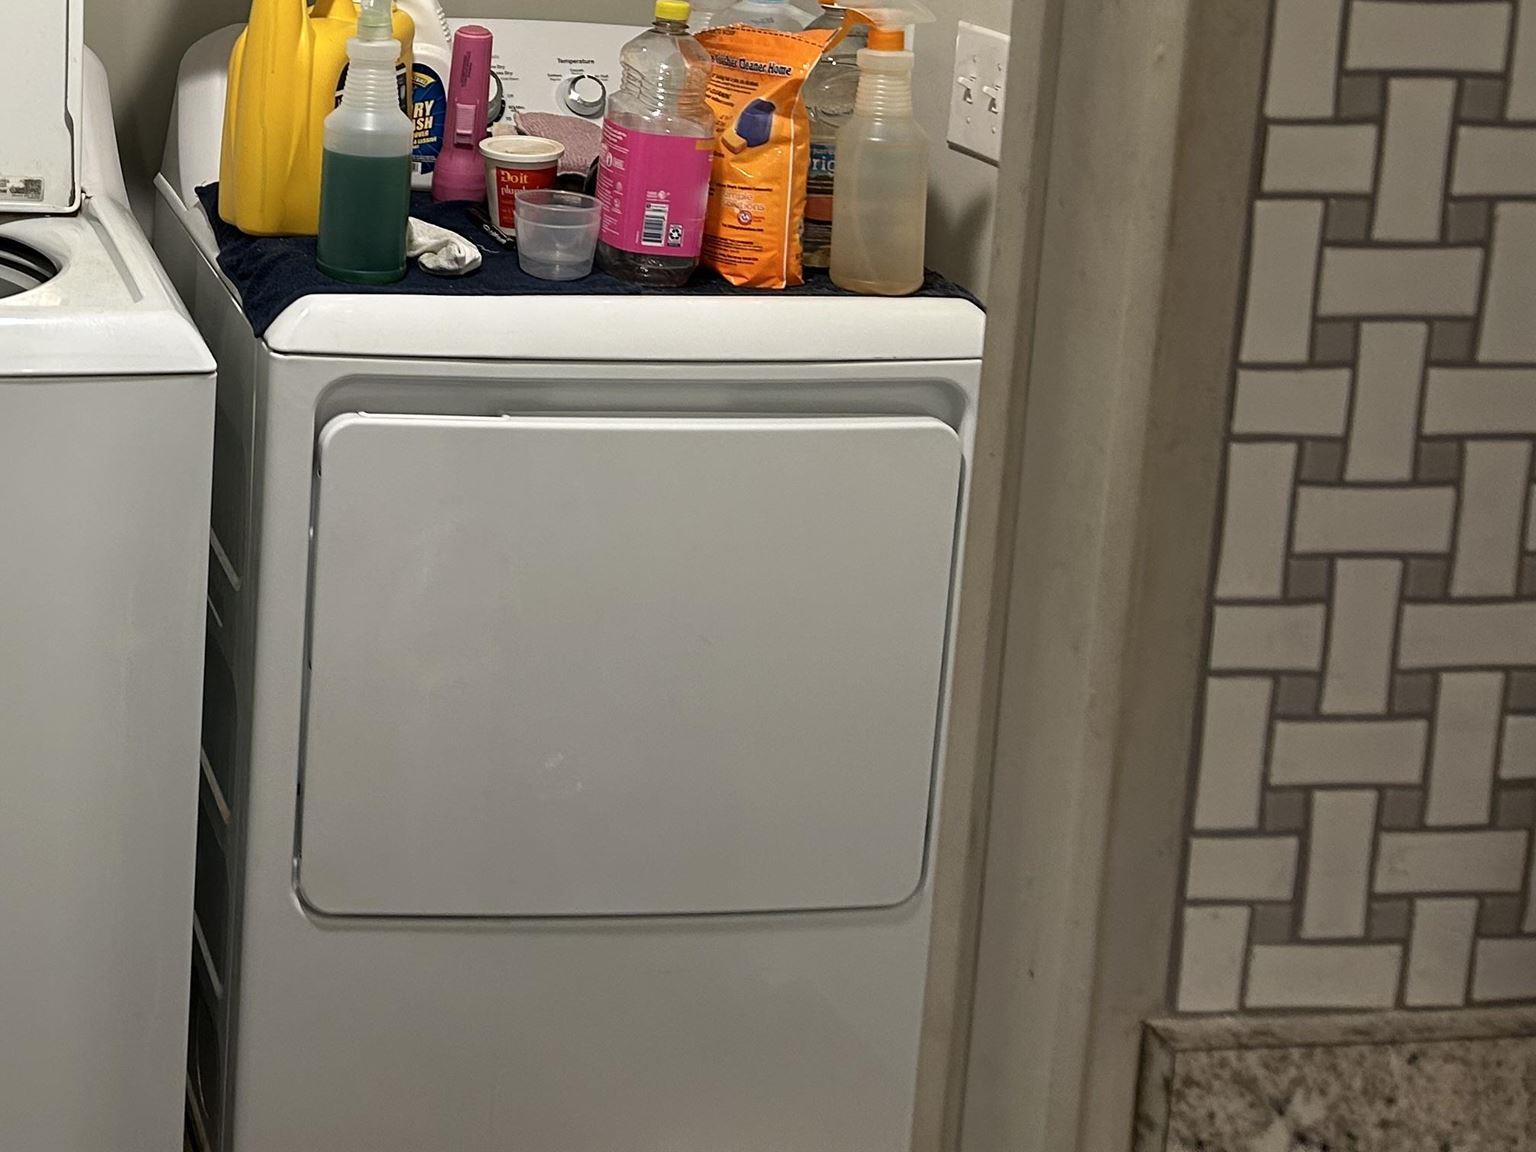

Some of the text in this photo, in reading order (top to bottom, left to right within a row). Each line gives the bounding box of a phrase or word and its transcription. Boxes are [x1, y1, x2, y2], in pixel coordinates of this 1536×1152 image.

[767, 63, 792, 76] Home
[413, 100, 434, 118] RY
[500, 170, 529, 184] Do it
